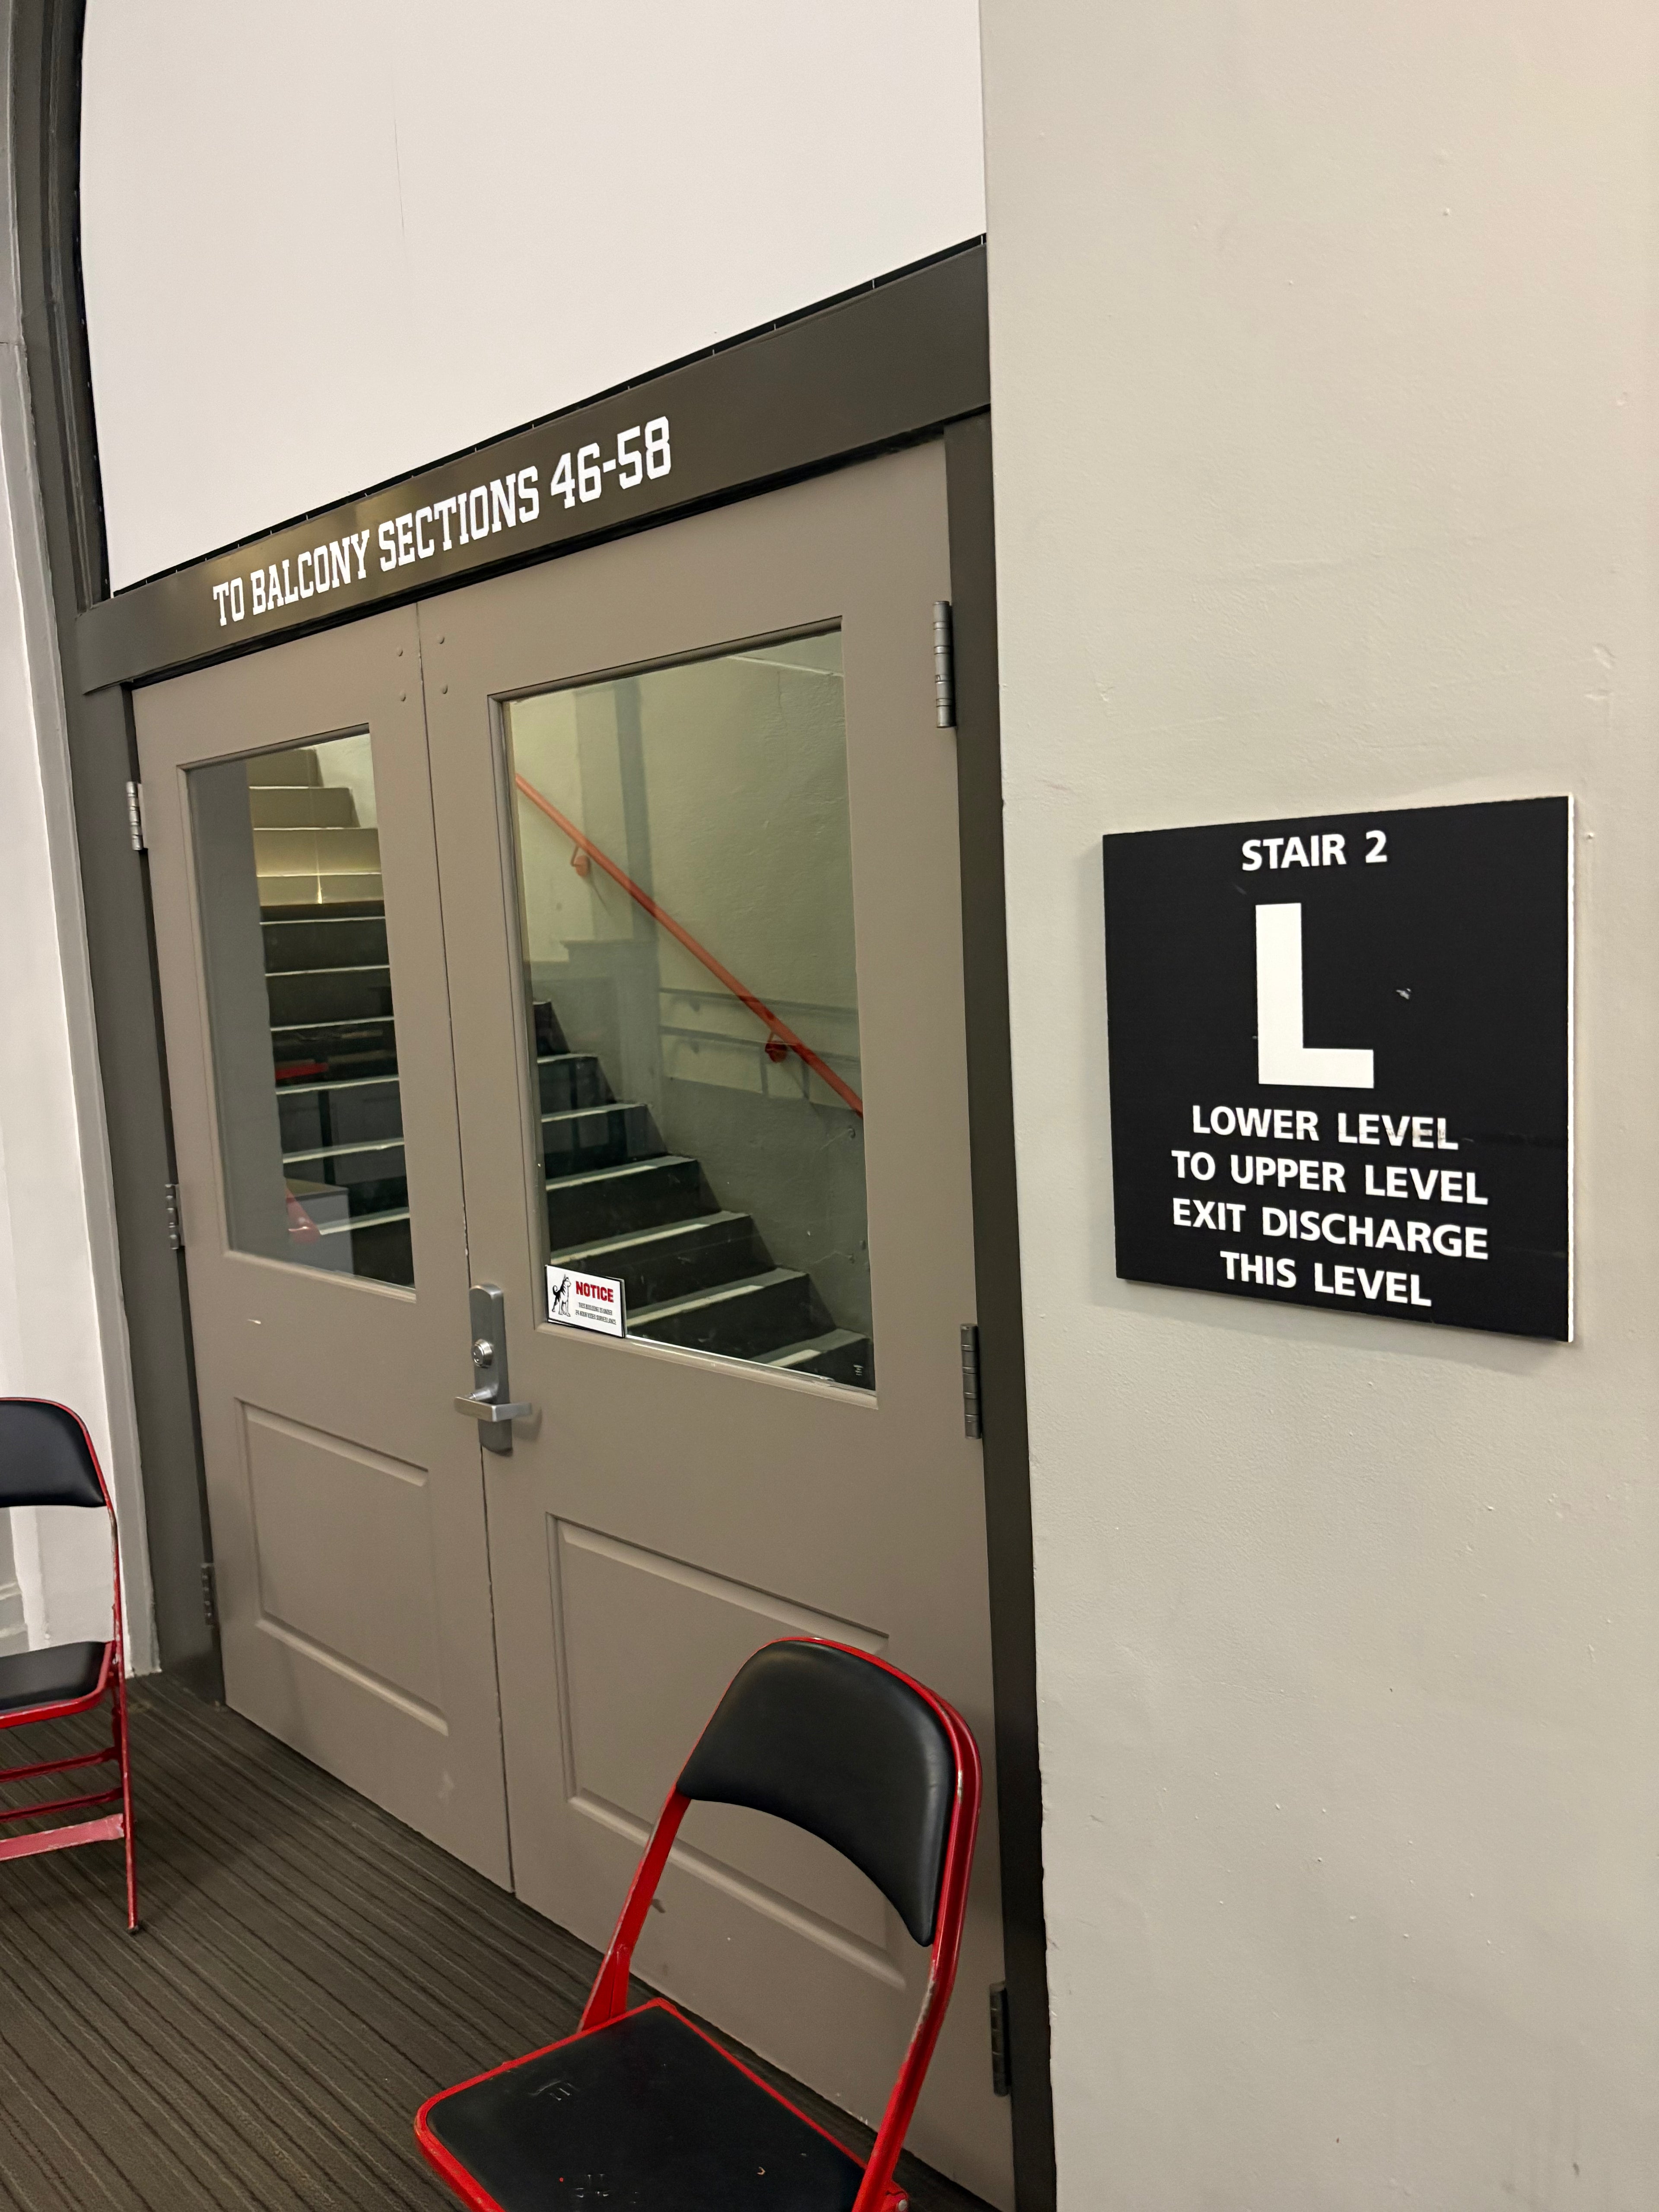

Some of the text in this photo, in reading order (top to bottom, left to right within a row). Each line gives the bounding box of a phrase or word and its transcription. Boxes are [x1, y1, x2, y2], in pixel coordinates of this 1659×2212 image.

[213, 416, 671, 626] TO BALCONY SECTIONS 46-58
[1241, 830, 1387, 871] STAIR 2
[1255, 903, 1374, 1089] L
[1192, 1105, 1459, 1150] LOWER LEVEL
[1171, 1150, 1488, 1205] TO UPPER LEVEL
[1173, 1198, 1489, 1260] EXIT DISCHARGE
[575, 1281, 614, 1303] NOTICE
[1220, 1251, 1432, 1306] THIS LEVEL
